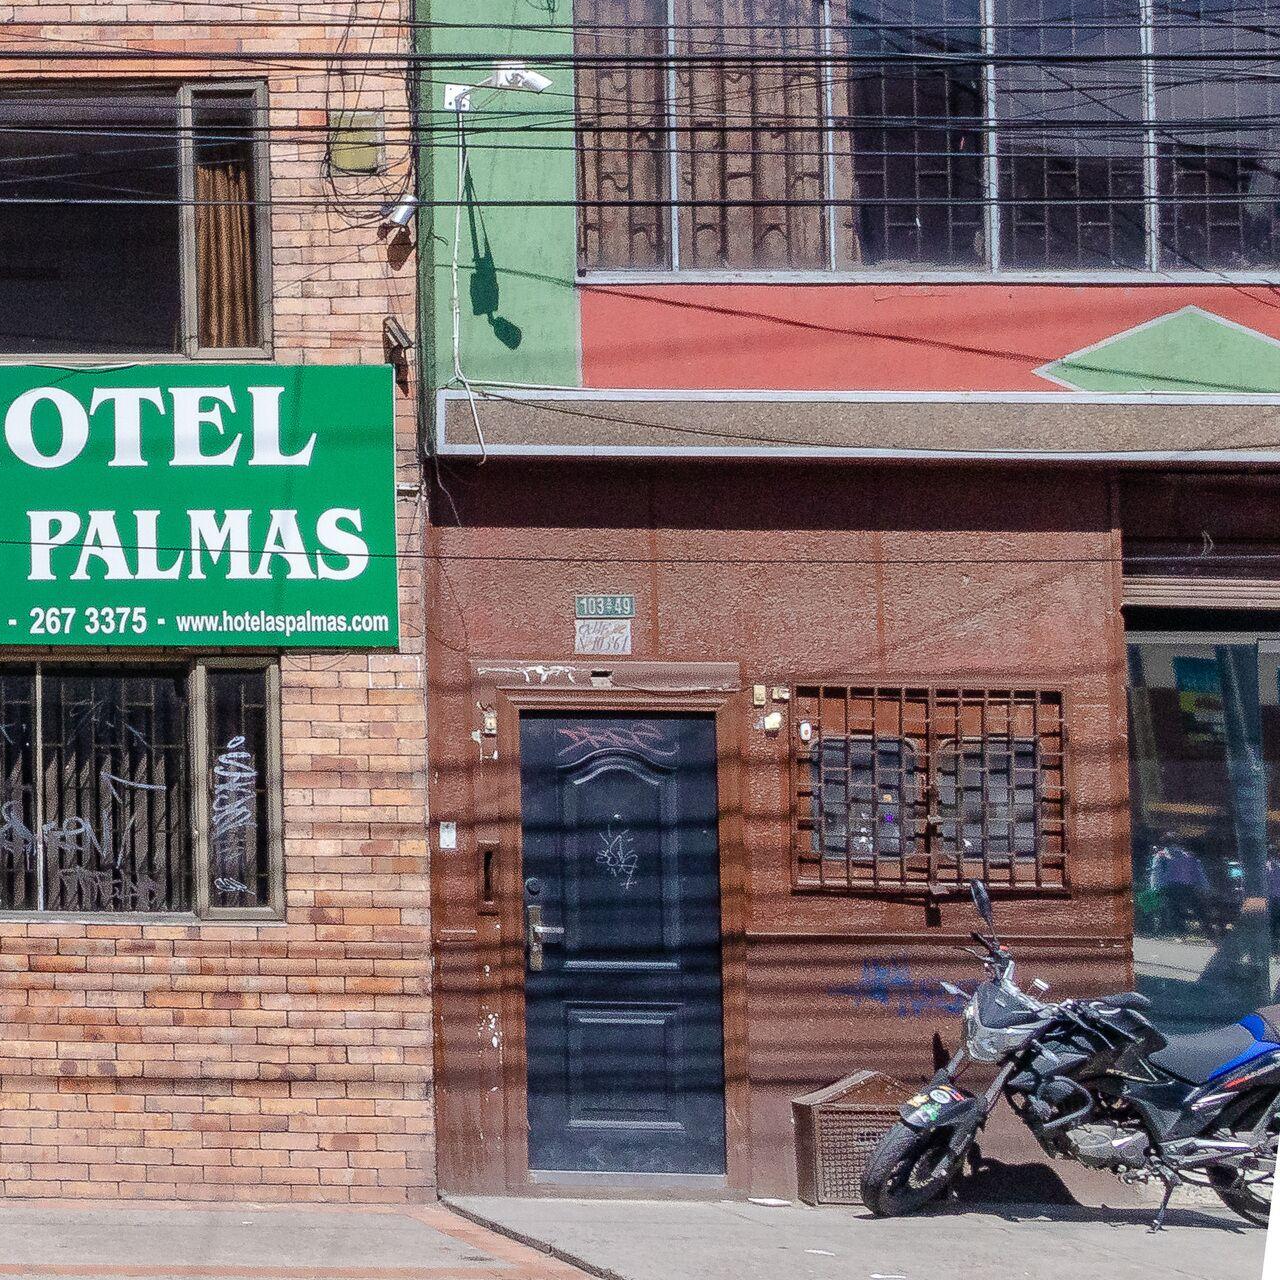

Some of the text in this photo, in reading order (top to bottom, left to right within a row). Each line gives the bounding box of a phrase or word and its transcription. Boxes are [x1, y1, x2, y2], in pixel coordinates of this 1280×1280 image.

[27, 507, 370, 581] PALMAS
[29, 607, 76, 634] 267
[85, 607, 147, 634] 3375
[176, 609, 389, 637] www.hotelaspalmas.com
